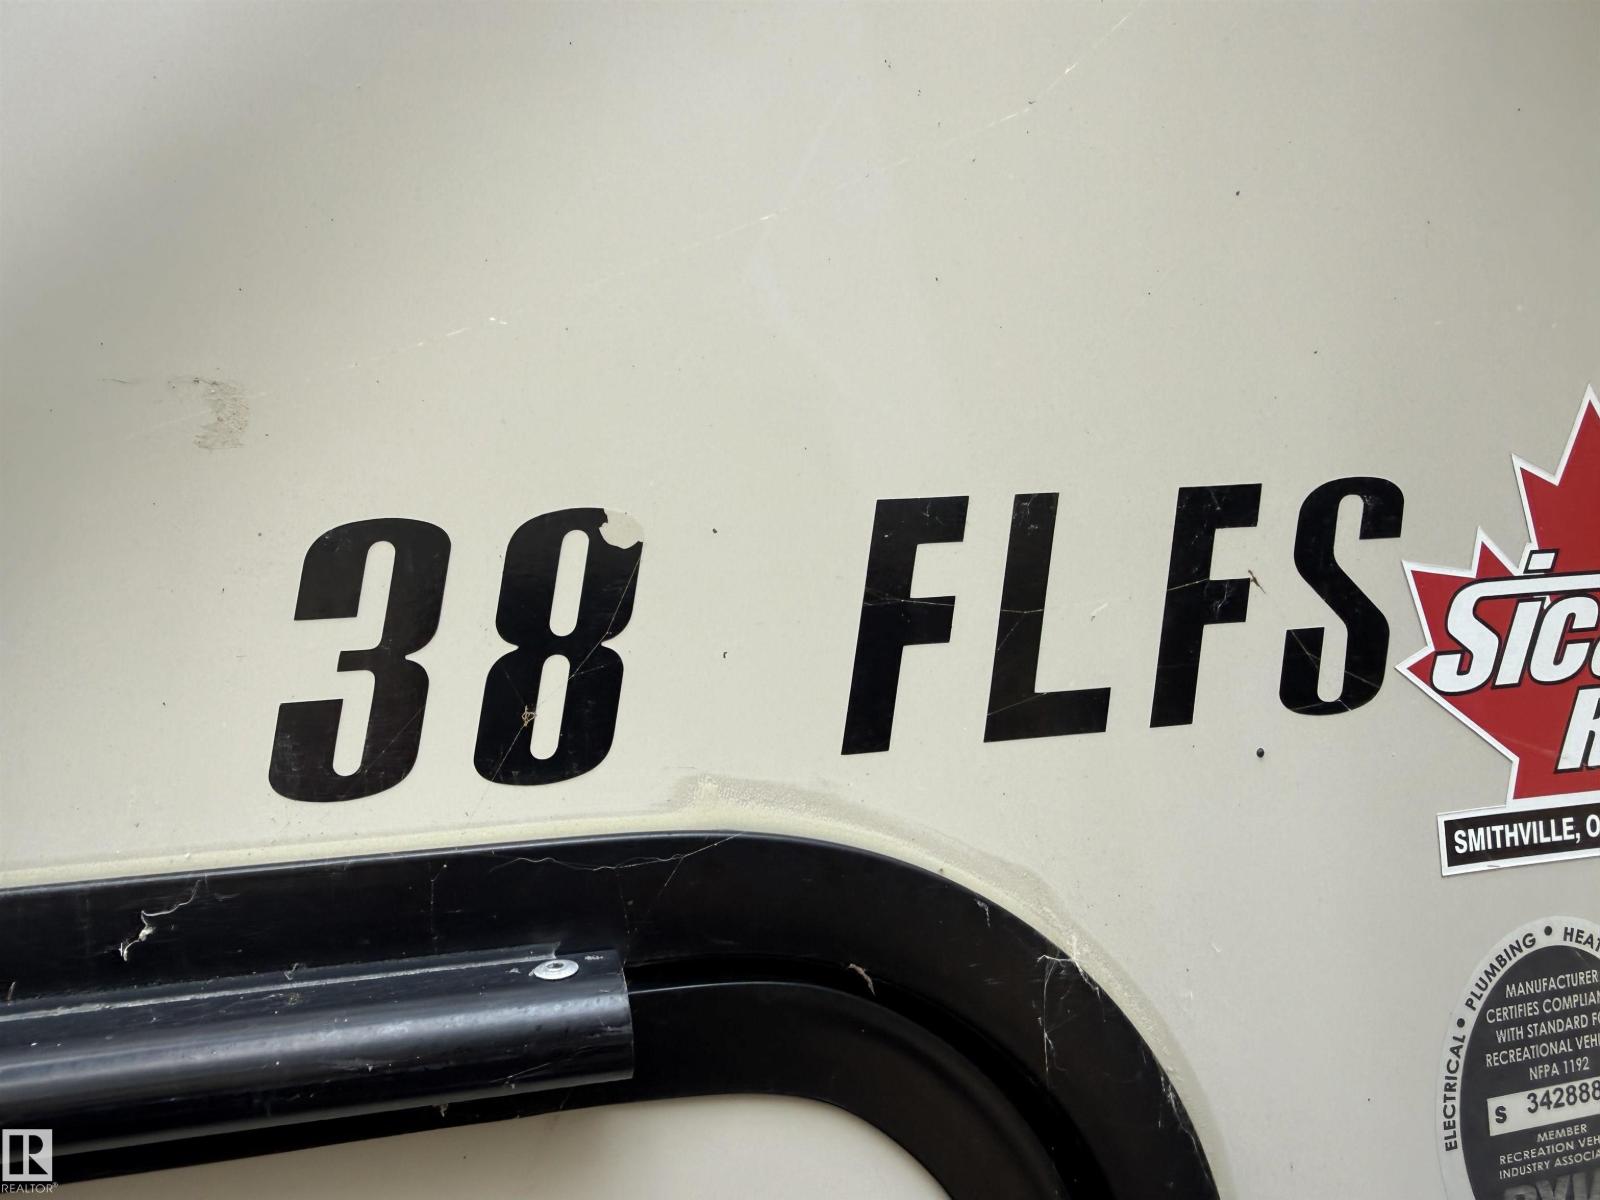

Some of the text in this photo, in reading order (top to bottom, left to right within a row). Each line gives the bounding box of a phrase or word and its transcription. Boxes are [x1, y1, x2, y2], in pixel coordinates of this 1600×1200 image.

[268, 476, 1405, 802] 38 FLFS
[1453, 816, 1580, 854] SMITHVILLE,
[1505, 969, 1599, 998] MANUFACTURER
[1486, 1001, 1540, 1023] CERTIFIES
[1496, 1026, 1524, 1043] WITH
[1527, 1014, 1588, 1038] STANDARD
[1443, 1034, 1466, 1152] ELECTRICAL
[1464, 932, 1537, 1011] PLUMBING
[1486, 1038, 1573, 1067] RECREATIONAL
[1529, 1056, 1590, 1080] NFPA 1192
[1495, 1105, 1507, 1124] S
[1537, 1123, 1587, 1142] MEMBER
[1500, 1141, 1574, 1165] RECREATION
[1499, 1160, 1550, 1179] INDUSTRY
